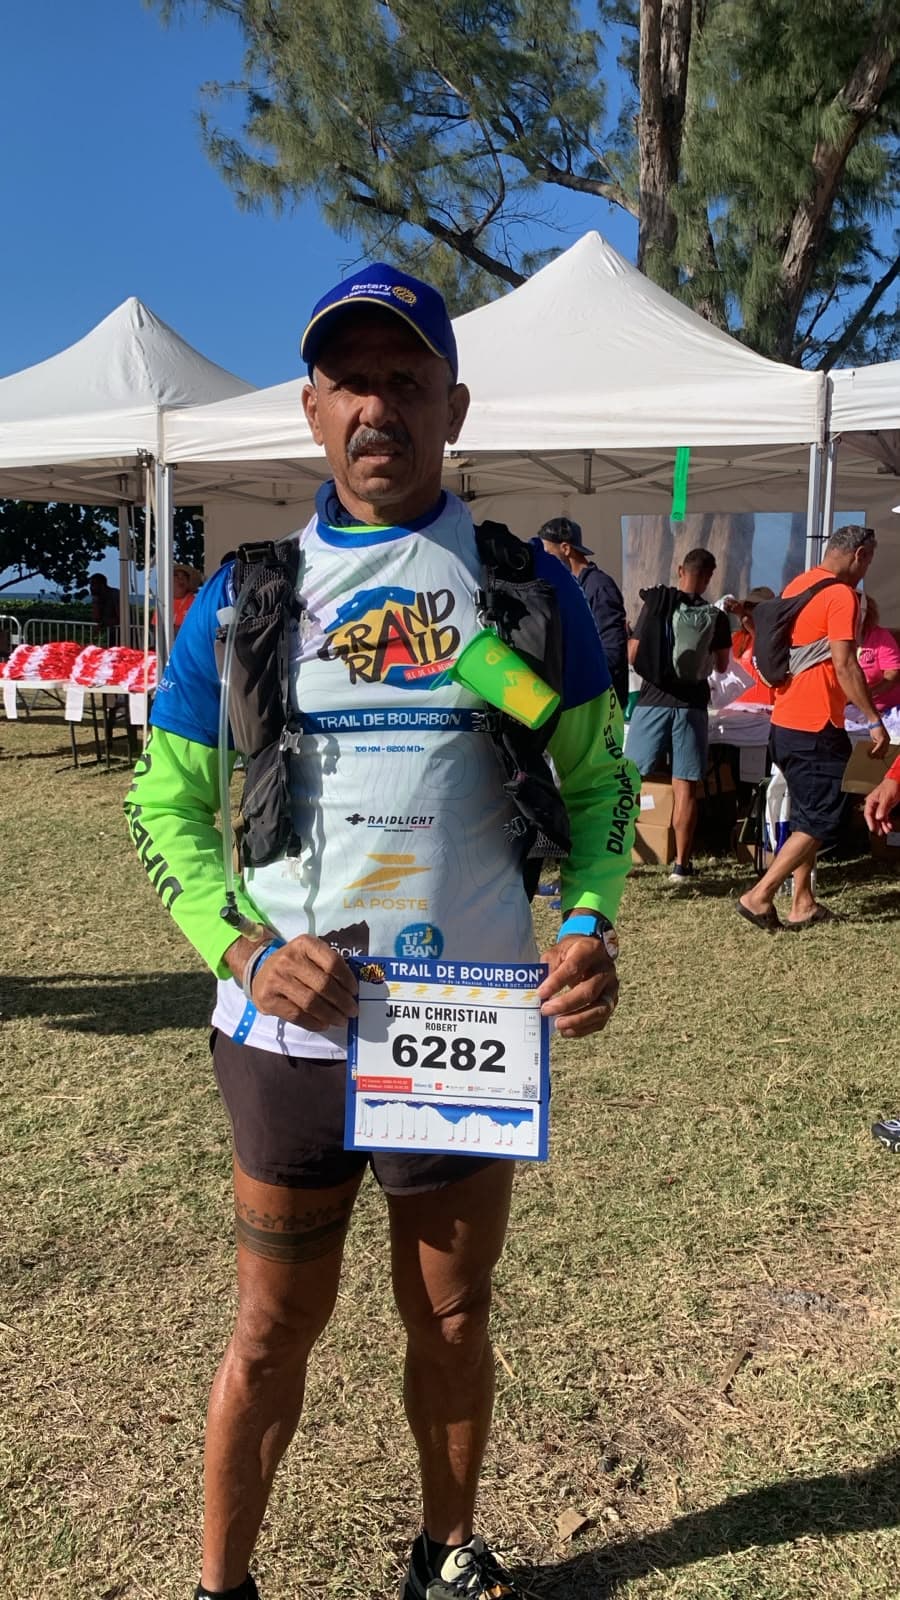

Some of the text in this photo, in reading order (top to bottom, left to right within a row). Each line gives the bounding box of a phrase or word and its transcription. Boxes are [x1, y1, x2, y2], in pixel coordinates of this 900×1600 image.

[352, 283, 392, 291] Rotary
[317, 588, 455, 681] GRAND
[347, 610, 460, 685] RAID
[317, 712, 461, 729] TRAIL DE BOURBON
[604, 725, 624, 760] DES
[367, 815, 435, 825] RAIDLIGHT
[343, 897, 429, 911] LA POSTE
[402, 944, 438, 958] BAN
[390, 962, 431, 978] TRAIL
[436, 965, 455, 979] DE
[386, 1005, 498, 1024] JEAN CHRISTIAN
[425, 1023, 458, 1032] ROBERT
[392, 1033, 506, 1074] 6282
